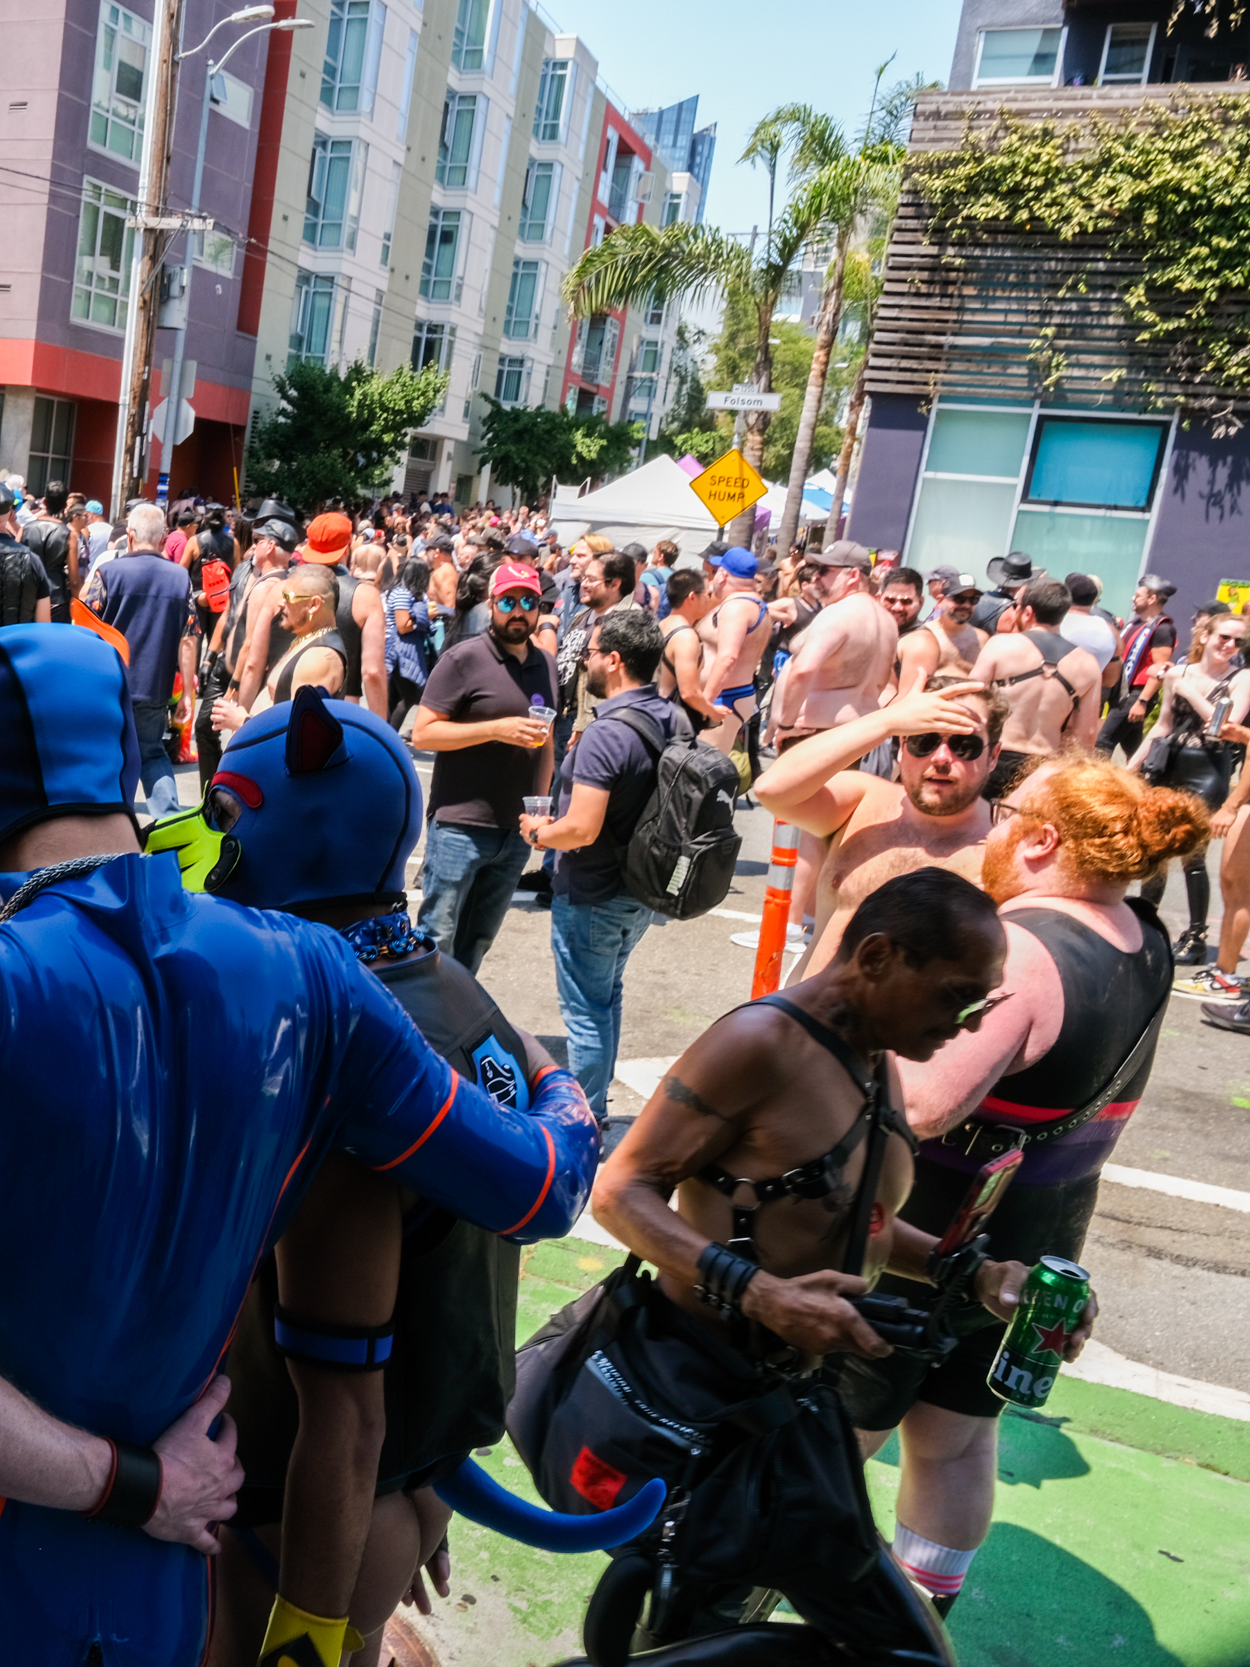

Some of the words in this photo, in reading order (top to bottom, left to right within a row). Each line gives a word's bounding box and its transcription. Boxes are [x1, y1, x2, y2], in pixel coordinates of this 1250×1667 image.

[724, 395, 763, 406] Folsom
[709, 475, 750, 489] SPEED
[708, 490, 745, 503] HUMP
